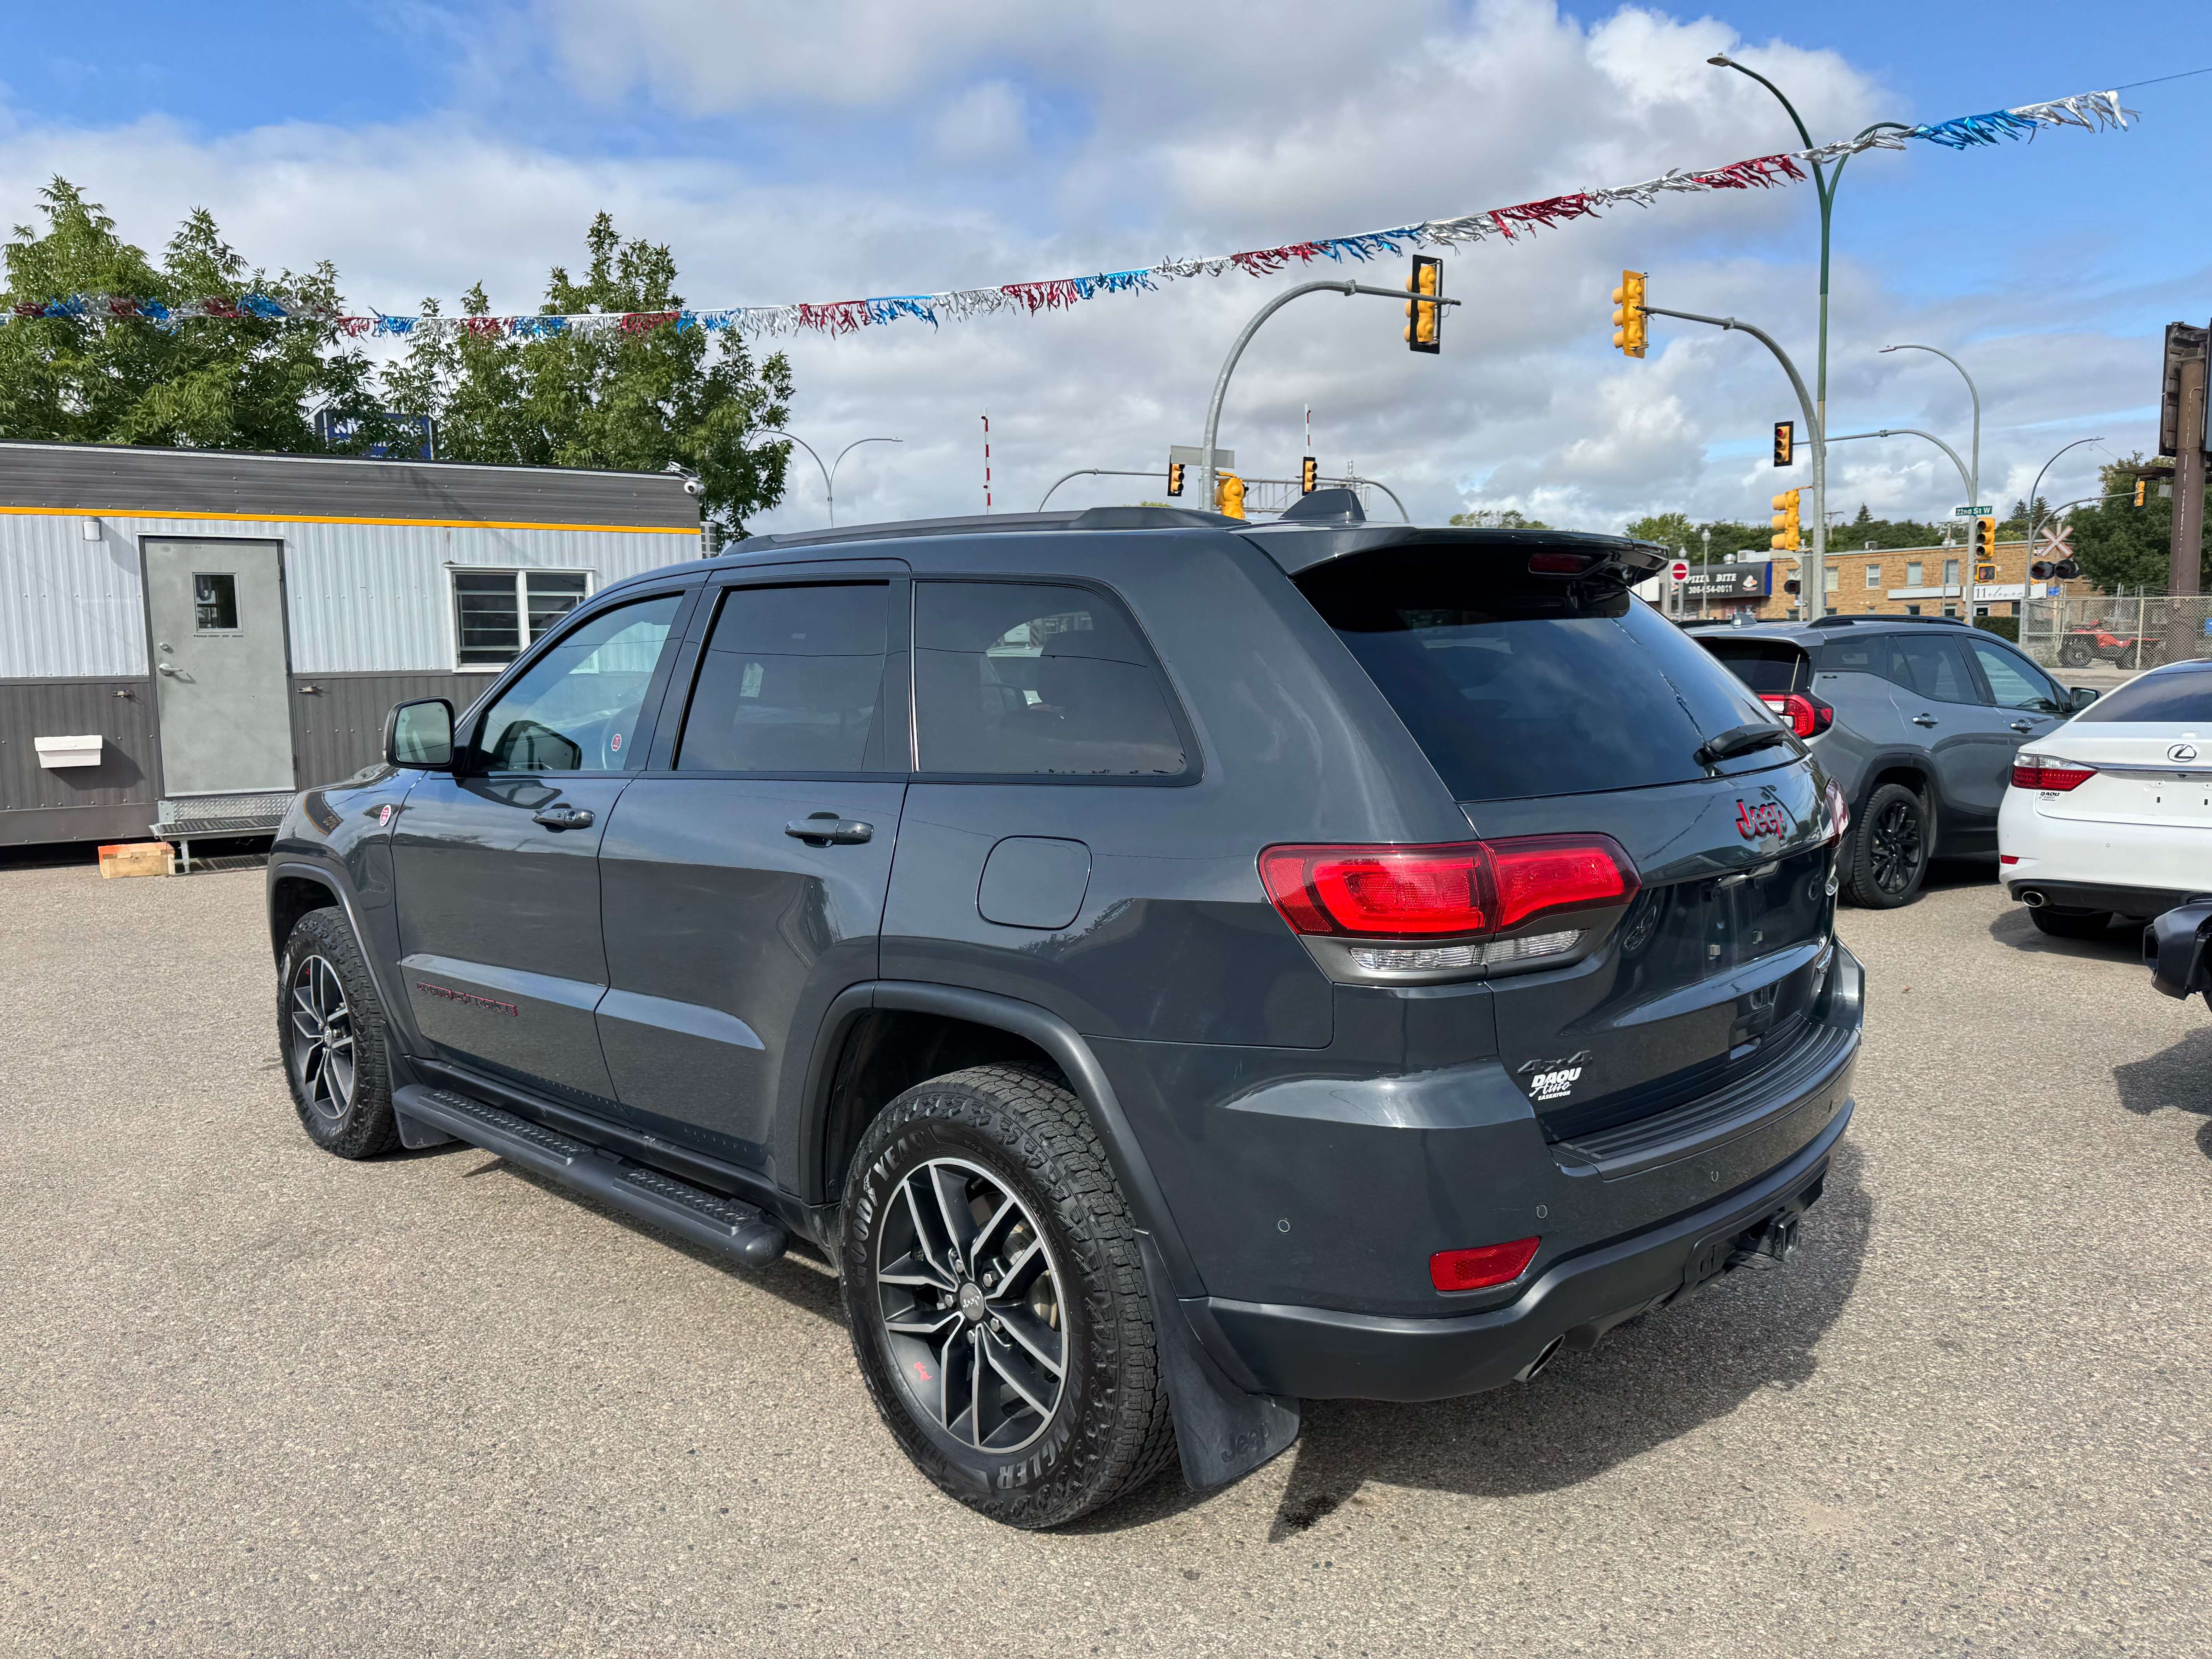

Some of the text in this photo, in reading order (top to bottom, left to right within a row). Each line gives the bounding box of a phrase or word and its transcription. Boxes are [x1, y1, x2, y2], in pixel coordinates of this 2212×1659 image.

[1716, 573, 1737, 582] BITE
[1735, 799, 1787, 842] Jeep
[1531, 1067, 1582, 1088] DAOU
[1529, 1080, 1571, 1097] Auto
[1537, 1090, 1571, 1101] SASKATOON
[1221, 1420, 1271, 1462] Jeep
